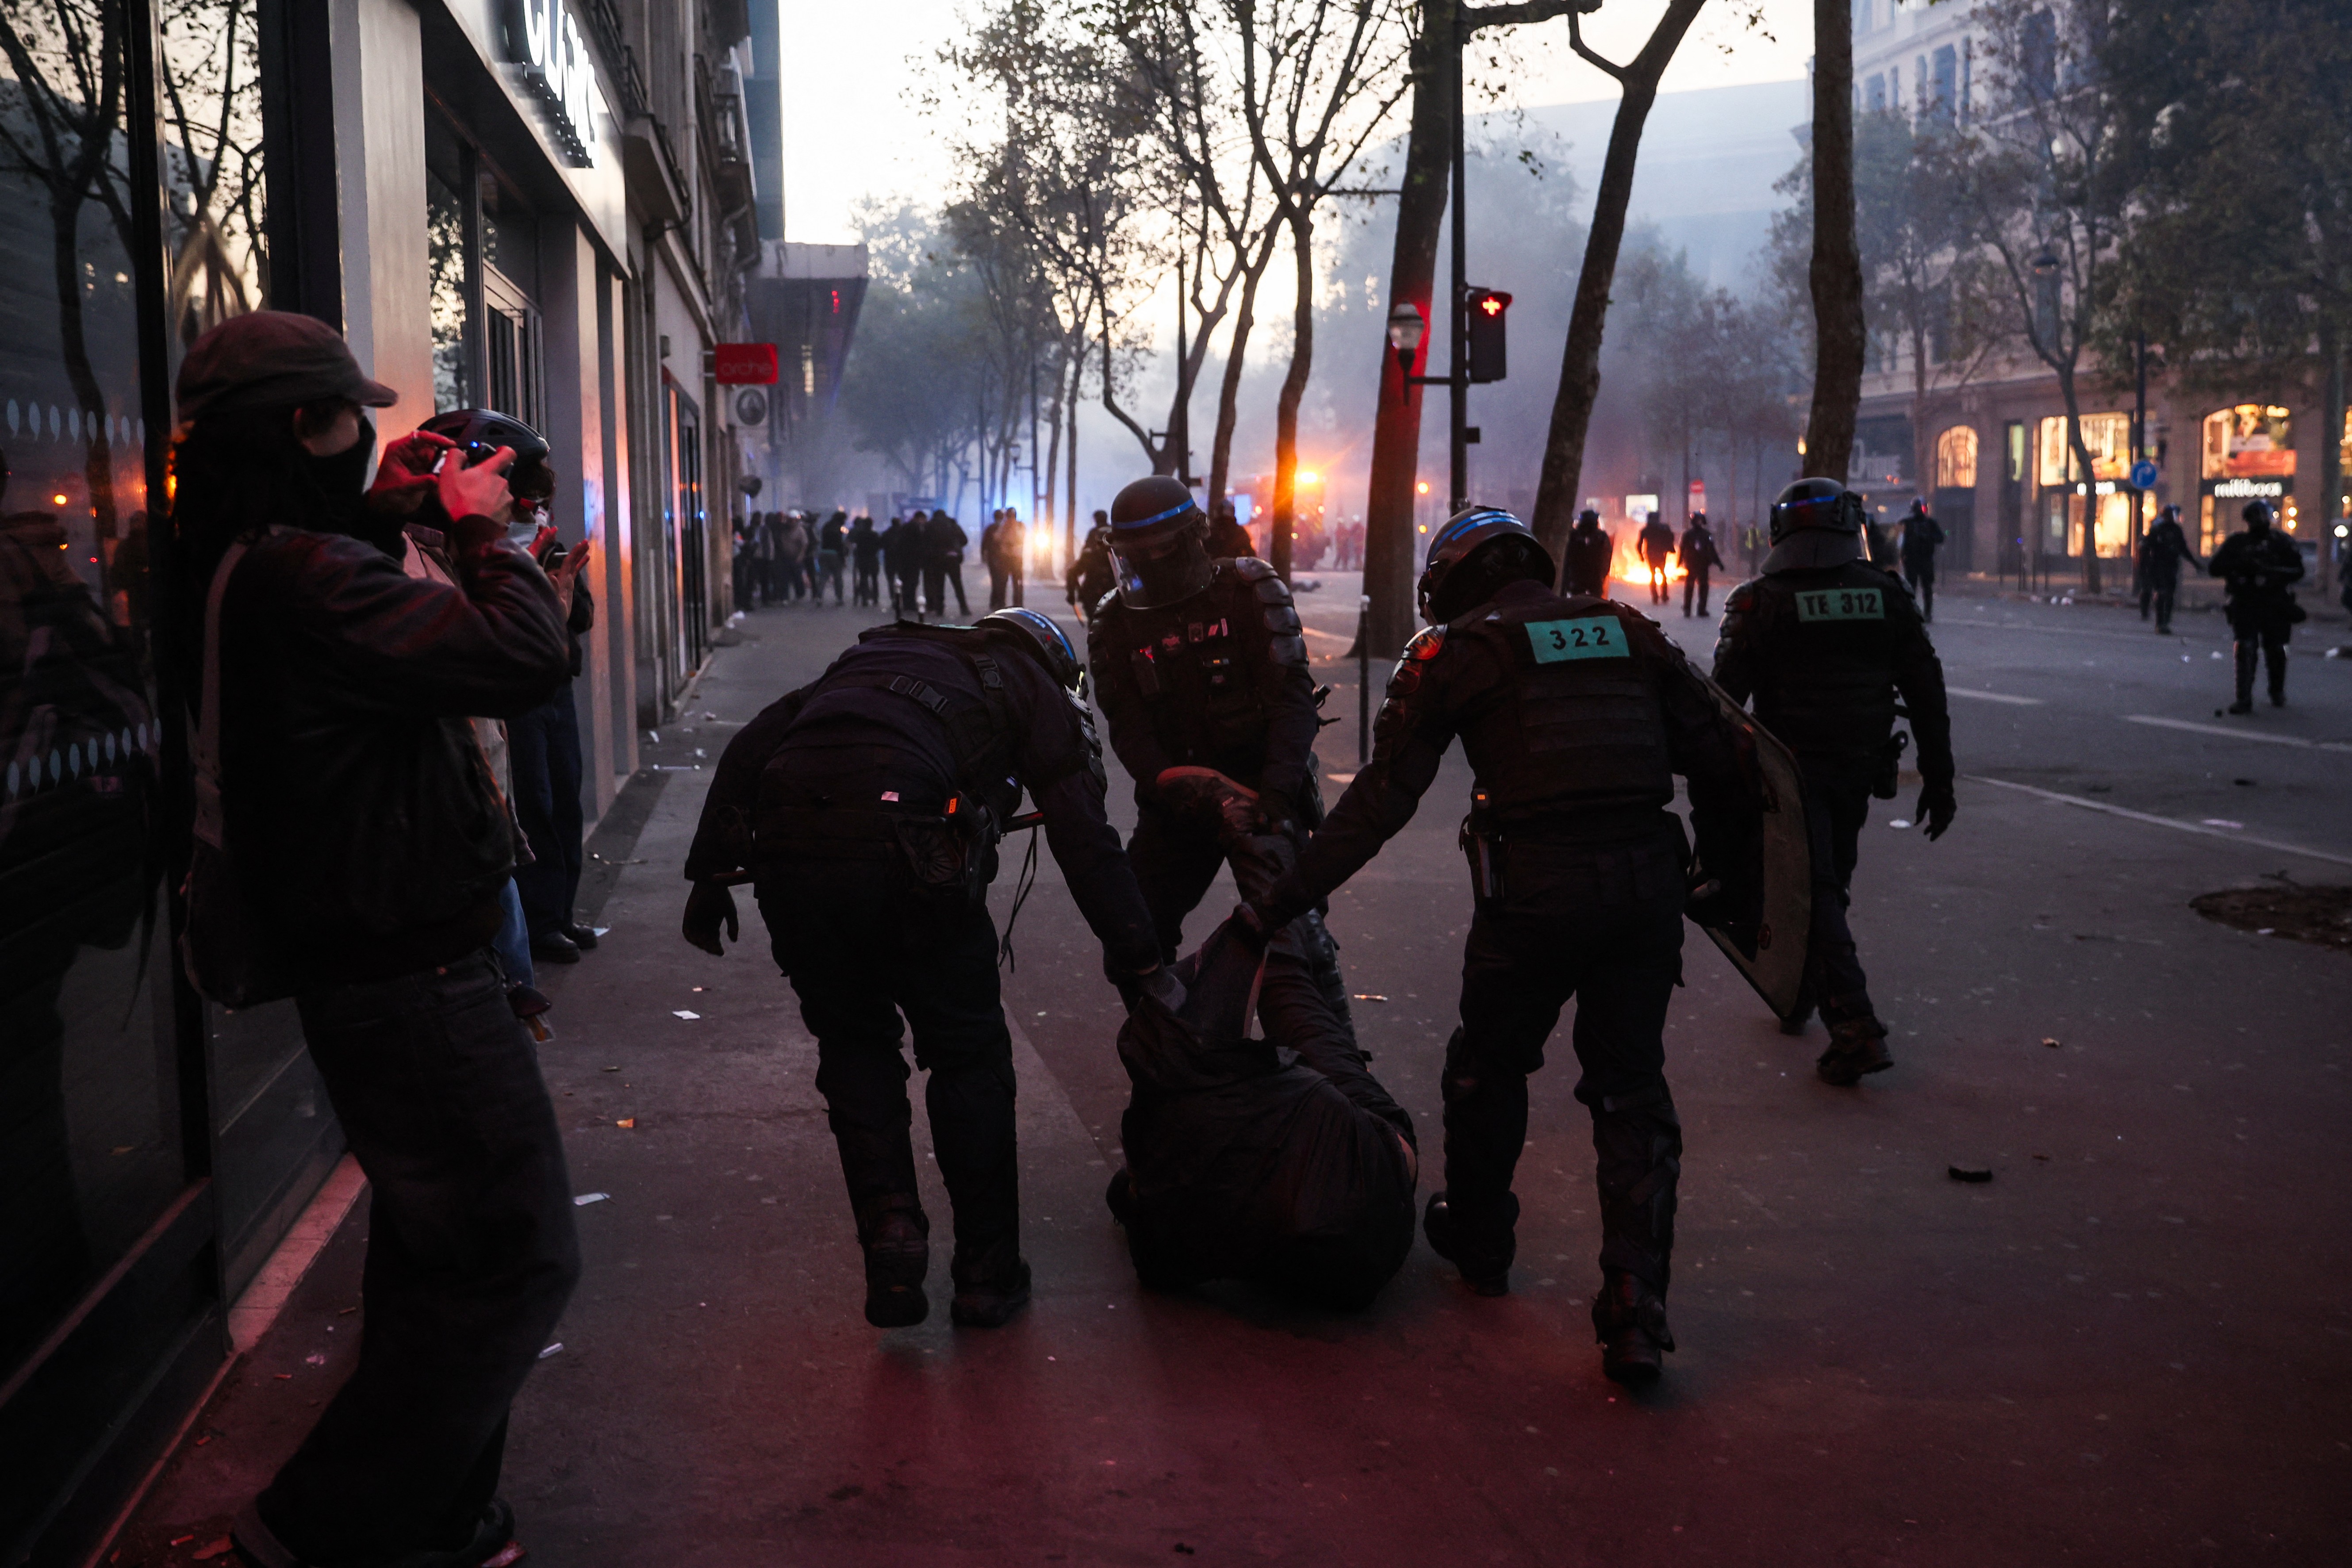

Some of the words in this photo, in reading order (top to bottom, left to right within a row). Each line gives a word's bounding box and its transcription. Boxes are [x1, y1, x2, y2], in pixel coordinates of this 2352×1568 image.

[1803, 594, 1829, 616] TE
[1840, 593, 1878, 614] 312
[1550, 626, 1610, 650] 322
